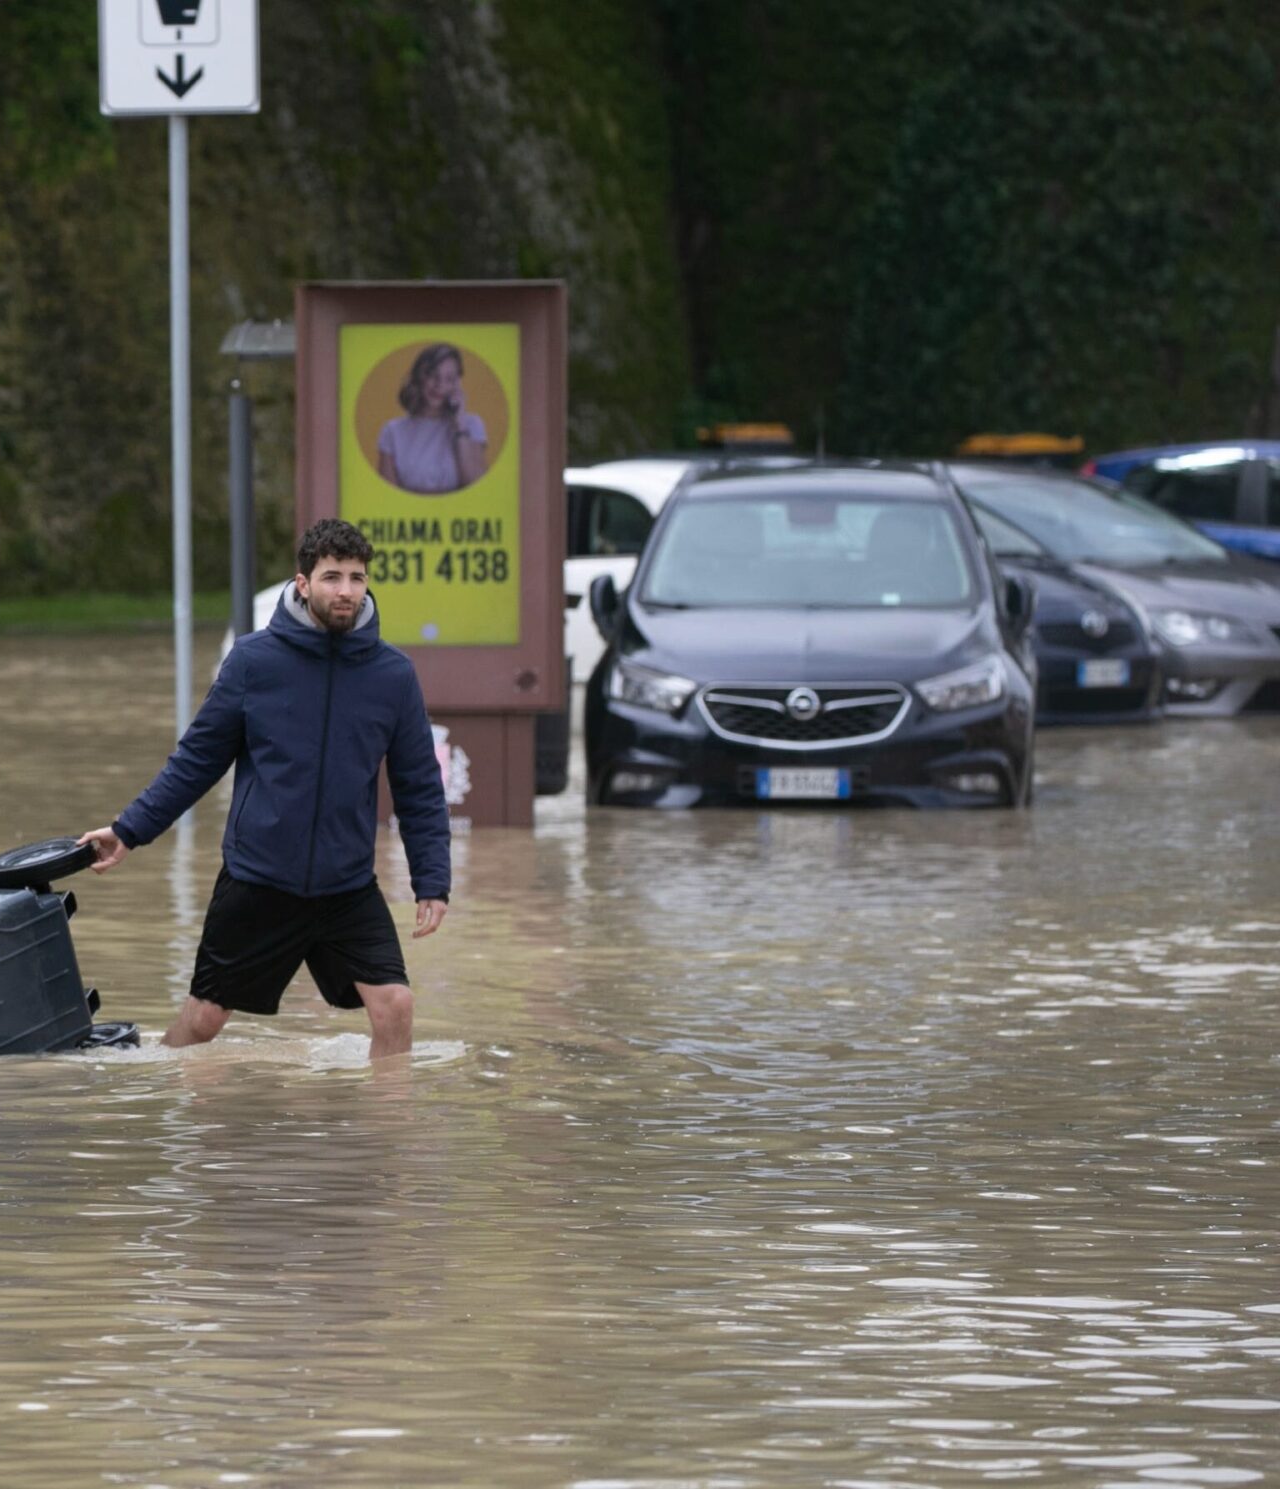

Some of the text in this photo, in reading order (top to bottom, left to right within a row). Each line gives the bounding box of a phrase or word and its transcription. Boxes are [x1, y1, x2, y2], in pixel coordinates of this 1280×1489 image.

[357, 518, 502, 543] CHIAMA ORA!
[369, 548, 508, 583] 331 4138
